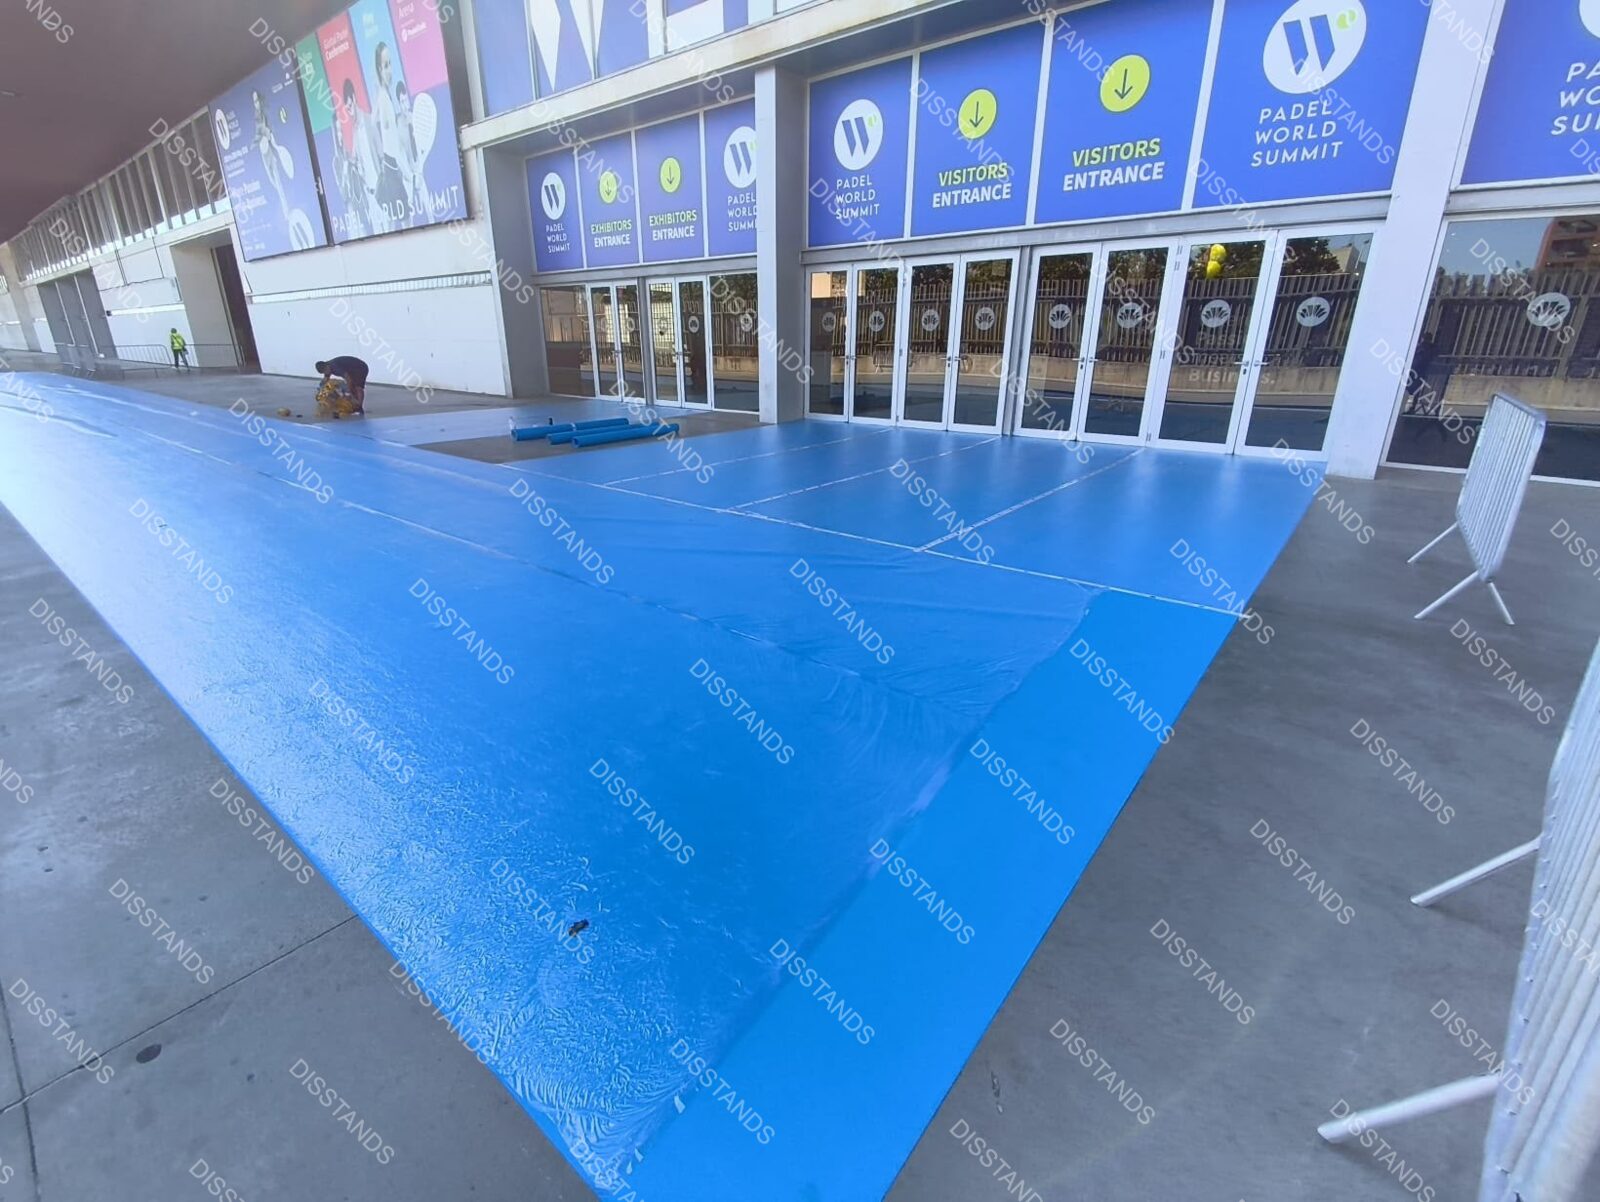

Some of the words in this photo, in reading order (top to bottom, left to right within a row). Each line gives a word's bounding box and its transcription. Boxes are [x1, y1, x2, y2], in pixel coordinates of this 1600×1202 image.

[1259, 99, 1333, 124] PADEL
[1255, 120, 1337, 145] WORLD
[1072, 138, 1161, 167] VISITORS
[1251, 141, 1343, 168] SUMMIT
[836, 174, 873, 190] PADEL
[938, 162, 1008, 187] VISITORS
[1063, 161, 1165, 191] ENTRANCE
[727, 193, 756, 206] PADEL
[835, 188, 876, 204] WORLD
[932, 183, 1012, 208] ENTRANCE
[366, 199, 405, 227] WRLD
[649, 209, 697, 226] EXHIBITORS
[835, 203, 880, 219] SUMMIT
[545, 223, 565, 233] PADEL
[591, 219, 632, 235] EXHIBITORS
[652, 225, 695, 241] ENTRANCE
[728, 219, 757, 232] SUMMI
[547, 233, 567, 243] WORLD
[594, 234, 631, 248] ENTRANCE
[548, 243, 571, 254] SUMMIT
